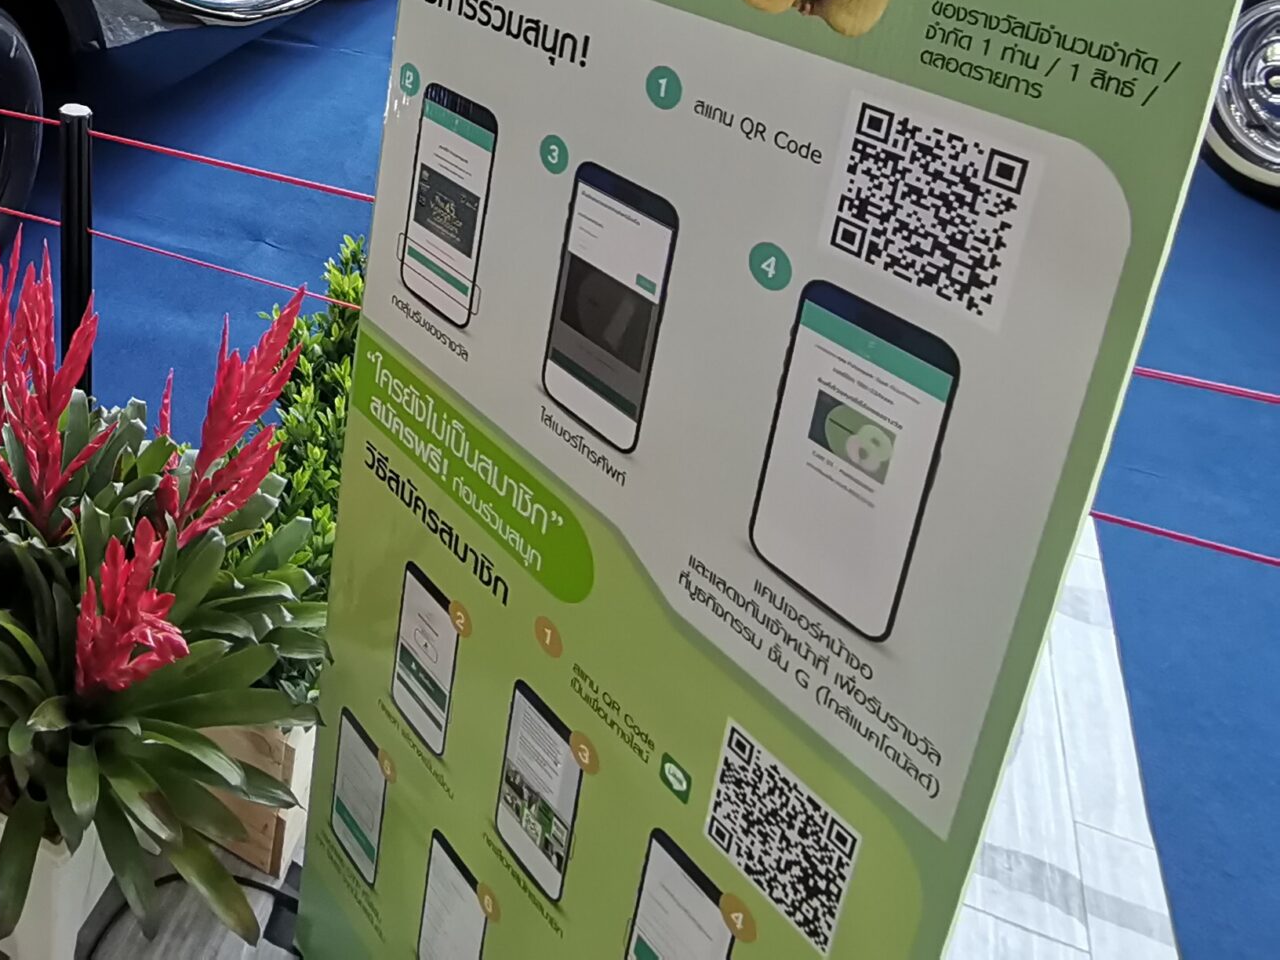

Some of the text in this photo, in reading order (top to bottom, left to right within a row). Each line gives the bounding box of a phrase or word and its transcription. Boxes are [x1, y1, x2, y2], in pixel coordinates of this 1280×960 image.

[924, 21, 973, 52] จำกัด
[982, 38, 991, 56] 1
[1000, 42, 1040, 71] ท่าน
[1071, 63, 1080, 82] 1
[931, 0, 1159, 76] ของรางวัลมีจำนวนจำกัด
[656, 79, 669, 98] 1
[920, 48, 1043, 100] ตลอดรายการ
[547, 145, 559, 164] 3
[693, 98, 823, 165] สแกน QR Code
[761, 255, 776, 279] 4
[391, 294, 469, 362] กดลุ้นรับของรางวัล
[540, 405, 628, 487] ใส่เบอร์โทรศัพท์
[370, 395, 543, 572] สมัครฟรี! ก่อนร่วมสนุก
[364, 440, 510, 607] วิธีสมัครสมาชิก
[456, 612, 465, 630] 2
[543, 626, 551, 645] 1
[753, 579, 874, 681] แคปเจอร์หน้าจอ
[678, 569, 941, 799] ที่บูธกิจกรรม ชั้น G (ใกล้แมคโดนัลด์)
[688, 554, 942, 768] และแสดงกับเจ้าหน้าที่ เพื่อรับรางวัล
[602, 692, 621, 717] QR
[624, 714, 655, 752] Code
[578, 744, 590, 764] 3
[730, 912, 743, 930] 4
